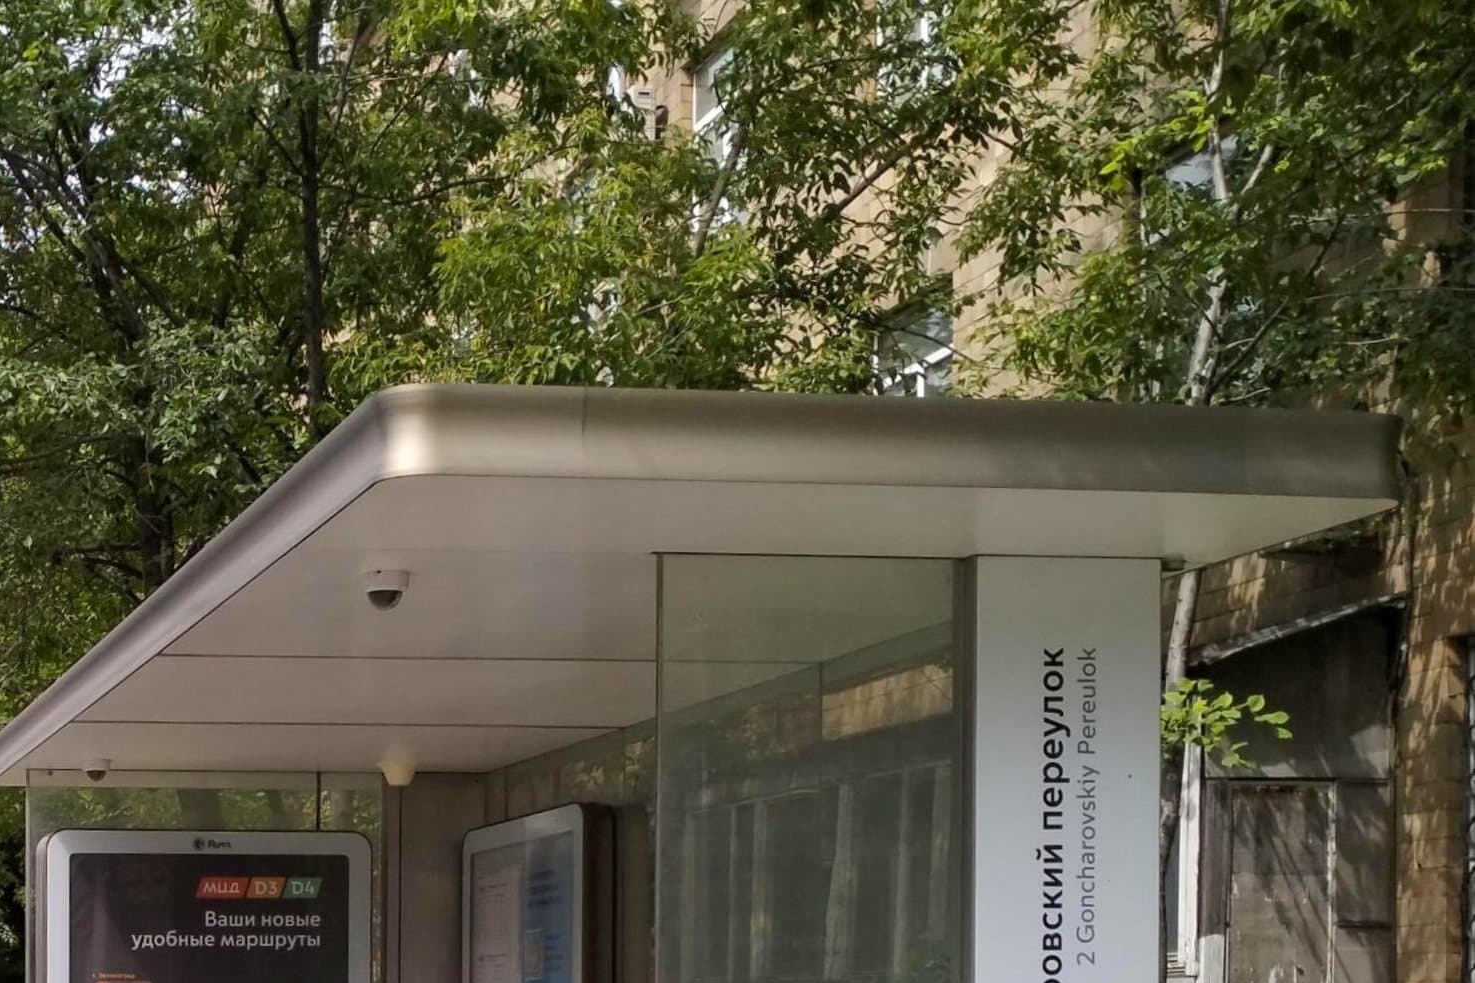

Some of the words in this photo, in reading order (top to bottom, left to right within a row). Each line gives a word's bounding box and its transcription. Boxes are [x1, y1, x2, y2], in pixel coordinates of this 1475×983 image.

[1077, 647, 1096, 755] Pereulok
[1042, 648, 1071, 830] переулок
[1076, 765, 1100, 943] Goncharovskiy
[202, 881, 240, 895] МЦД
[254, 881, 278, 895] D3
[291, 881, 315, 895] D4
[205, 910, 255, 927] Ваши
[261, 914, 321, 927] новые
[131, 930, 215, 950] удобные
[220, 934, 321, 950] маршруты
[1076, 951, 1096, 966] 2
